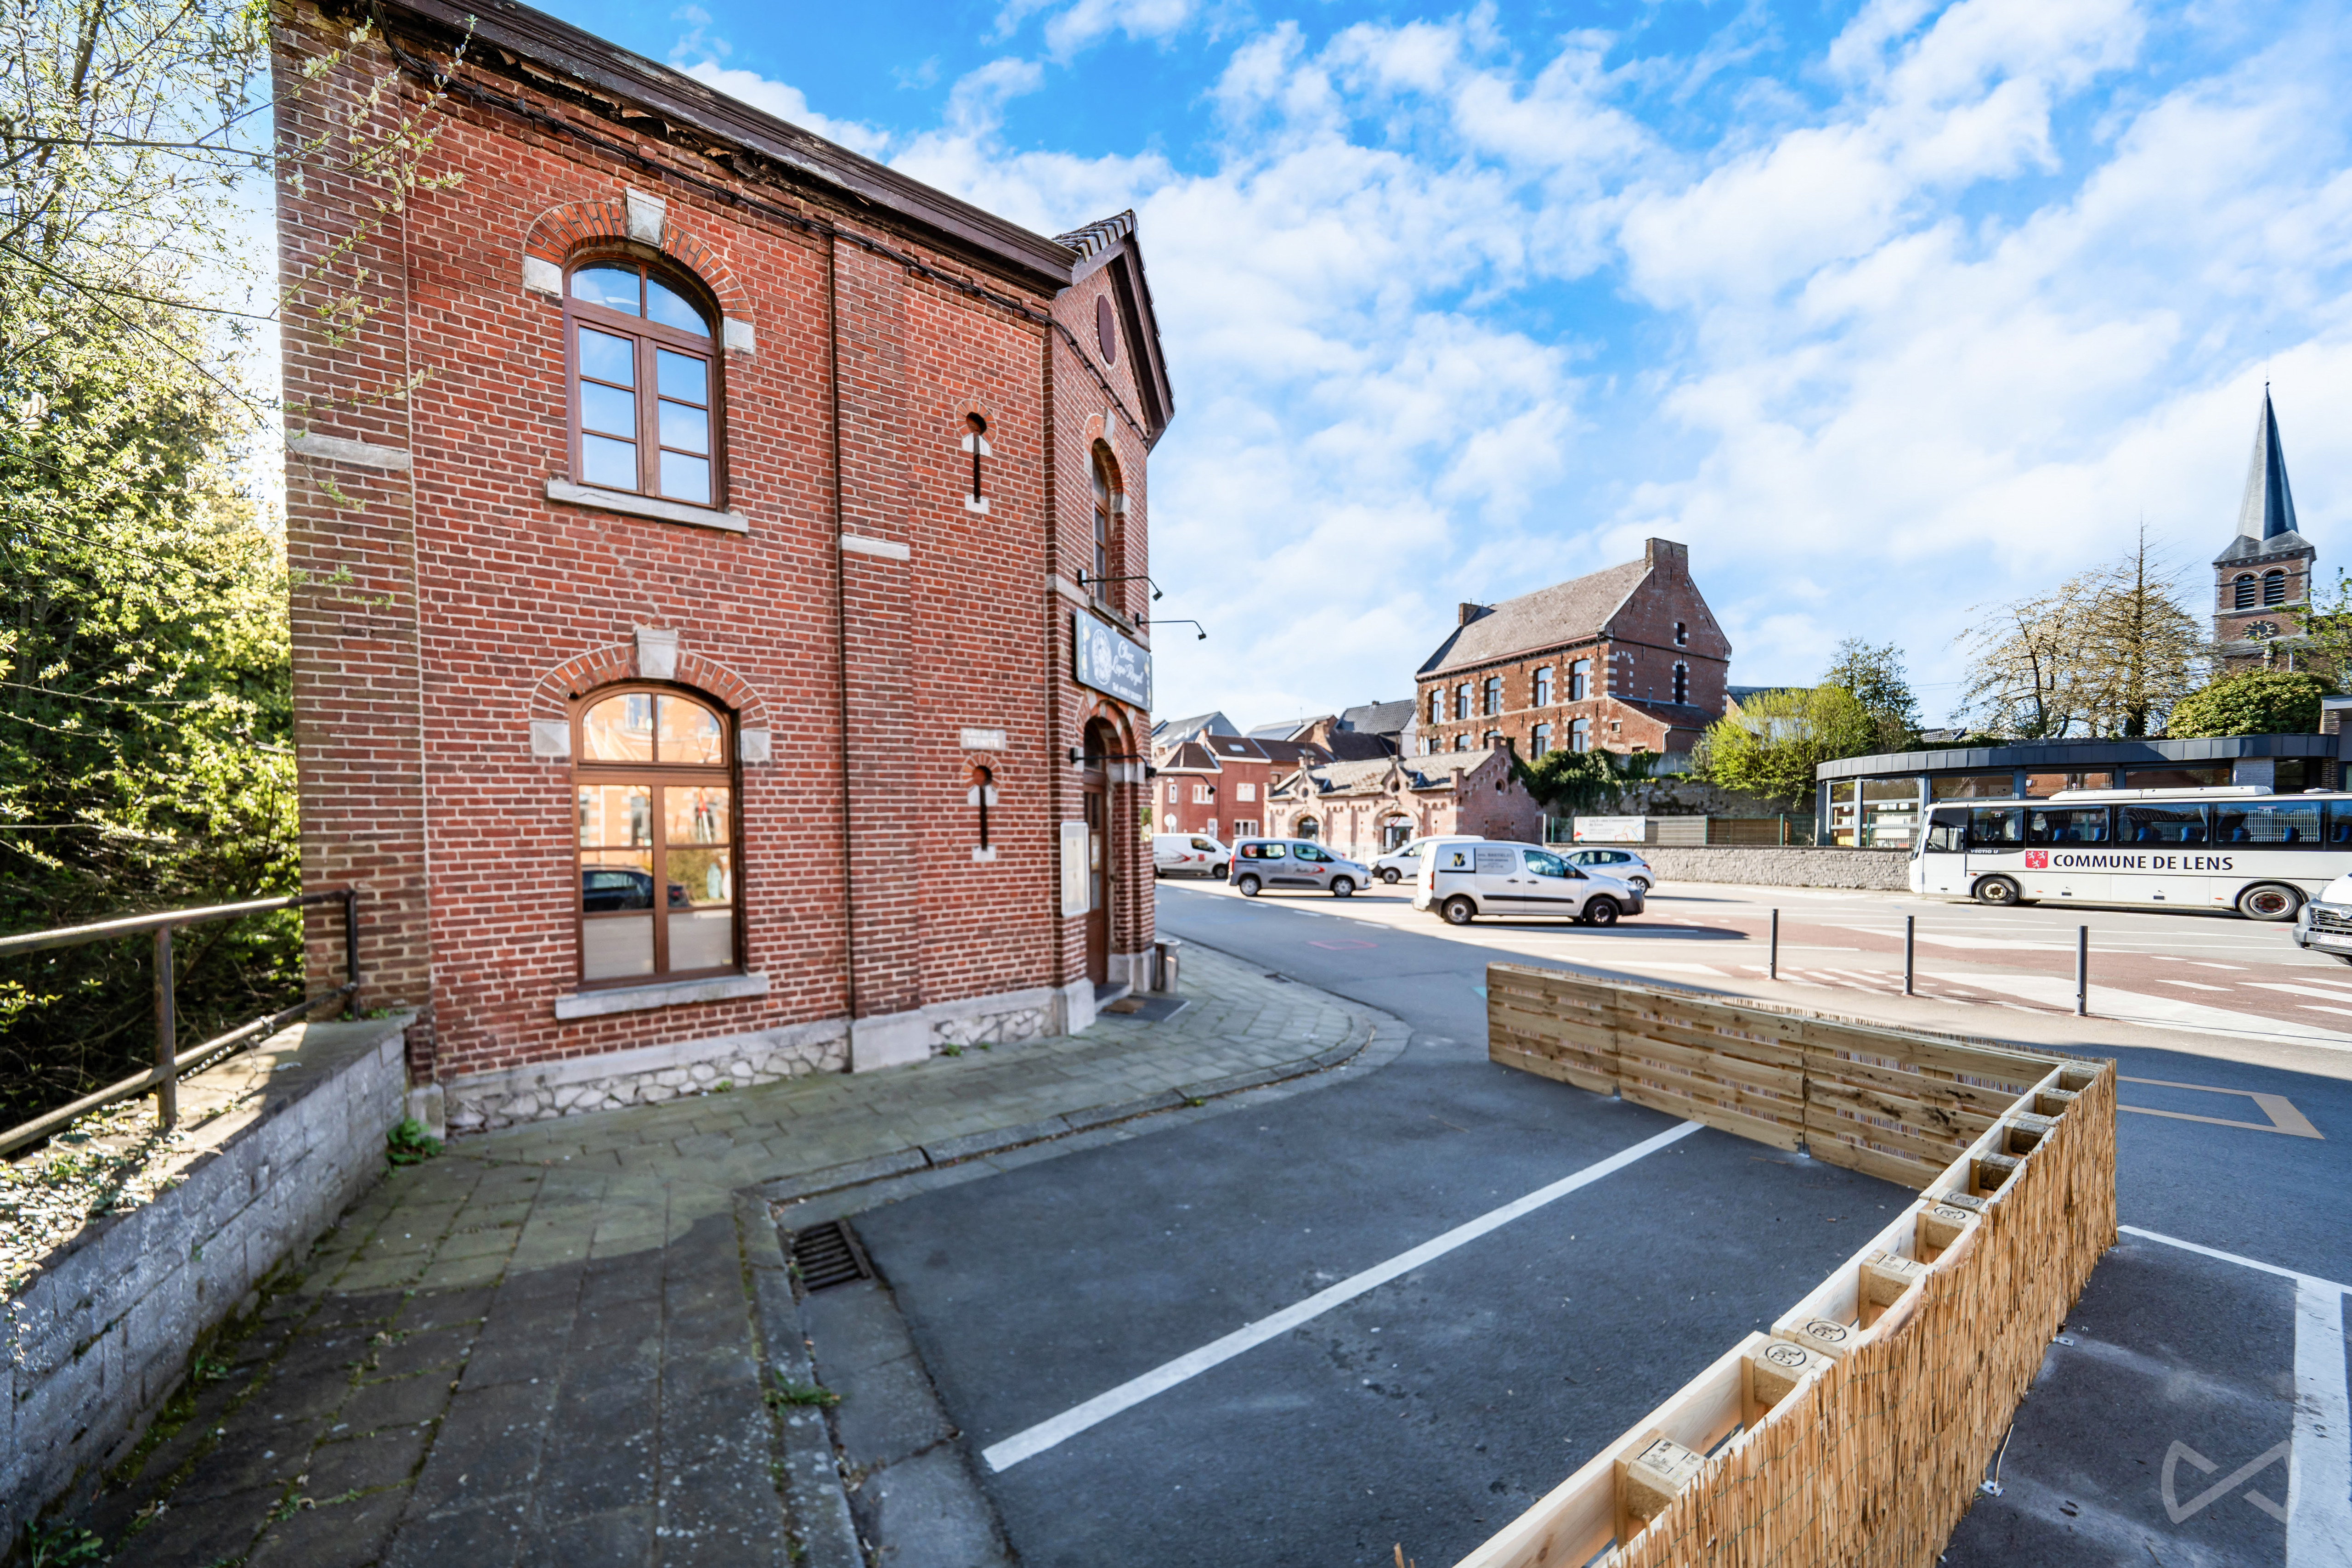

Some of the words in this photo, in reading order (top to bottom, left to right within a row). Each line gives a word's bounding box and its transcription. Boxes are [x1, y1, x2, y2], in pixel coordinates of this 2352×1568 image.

[2053, 855, 2146, 868] COMMUNE
[2153, 856, 2177, 869] DE
[2183, 856, 2233, 870] LENS
